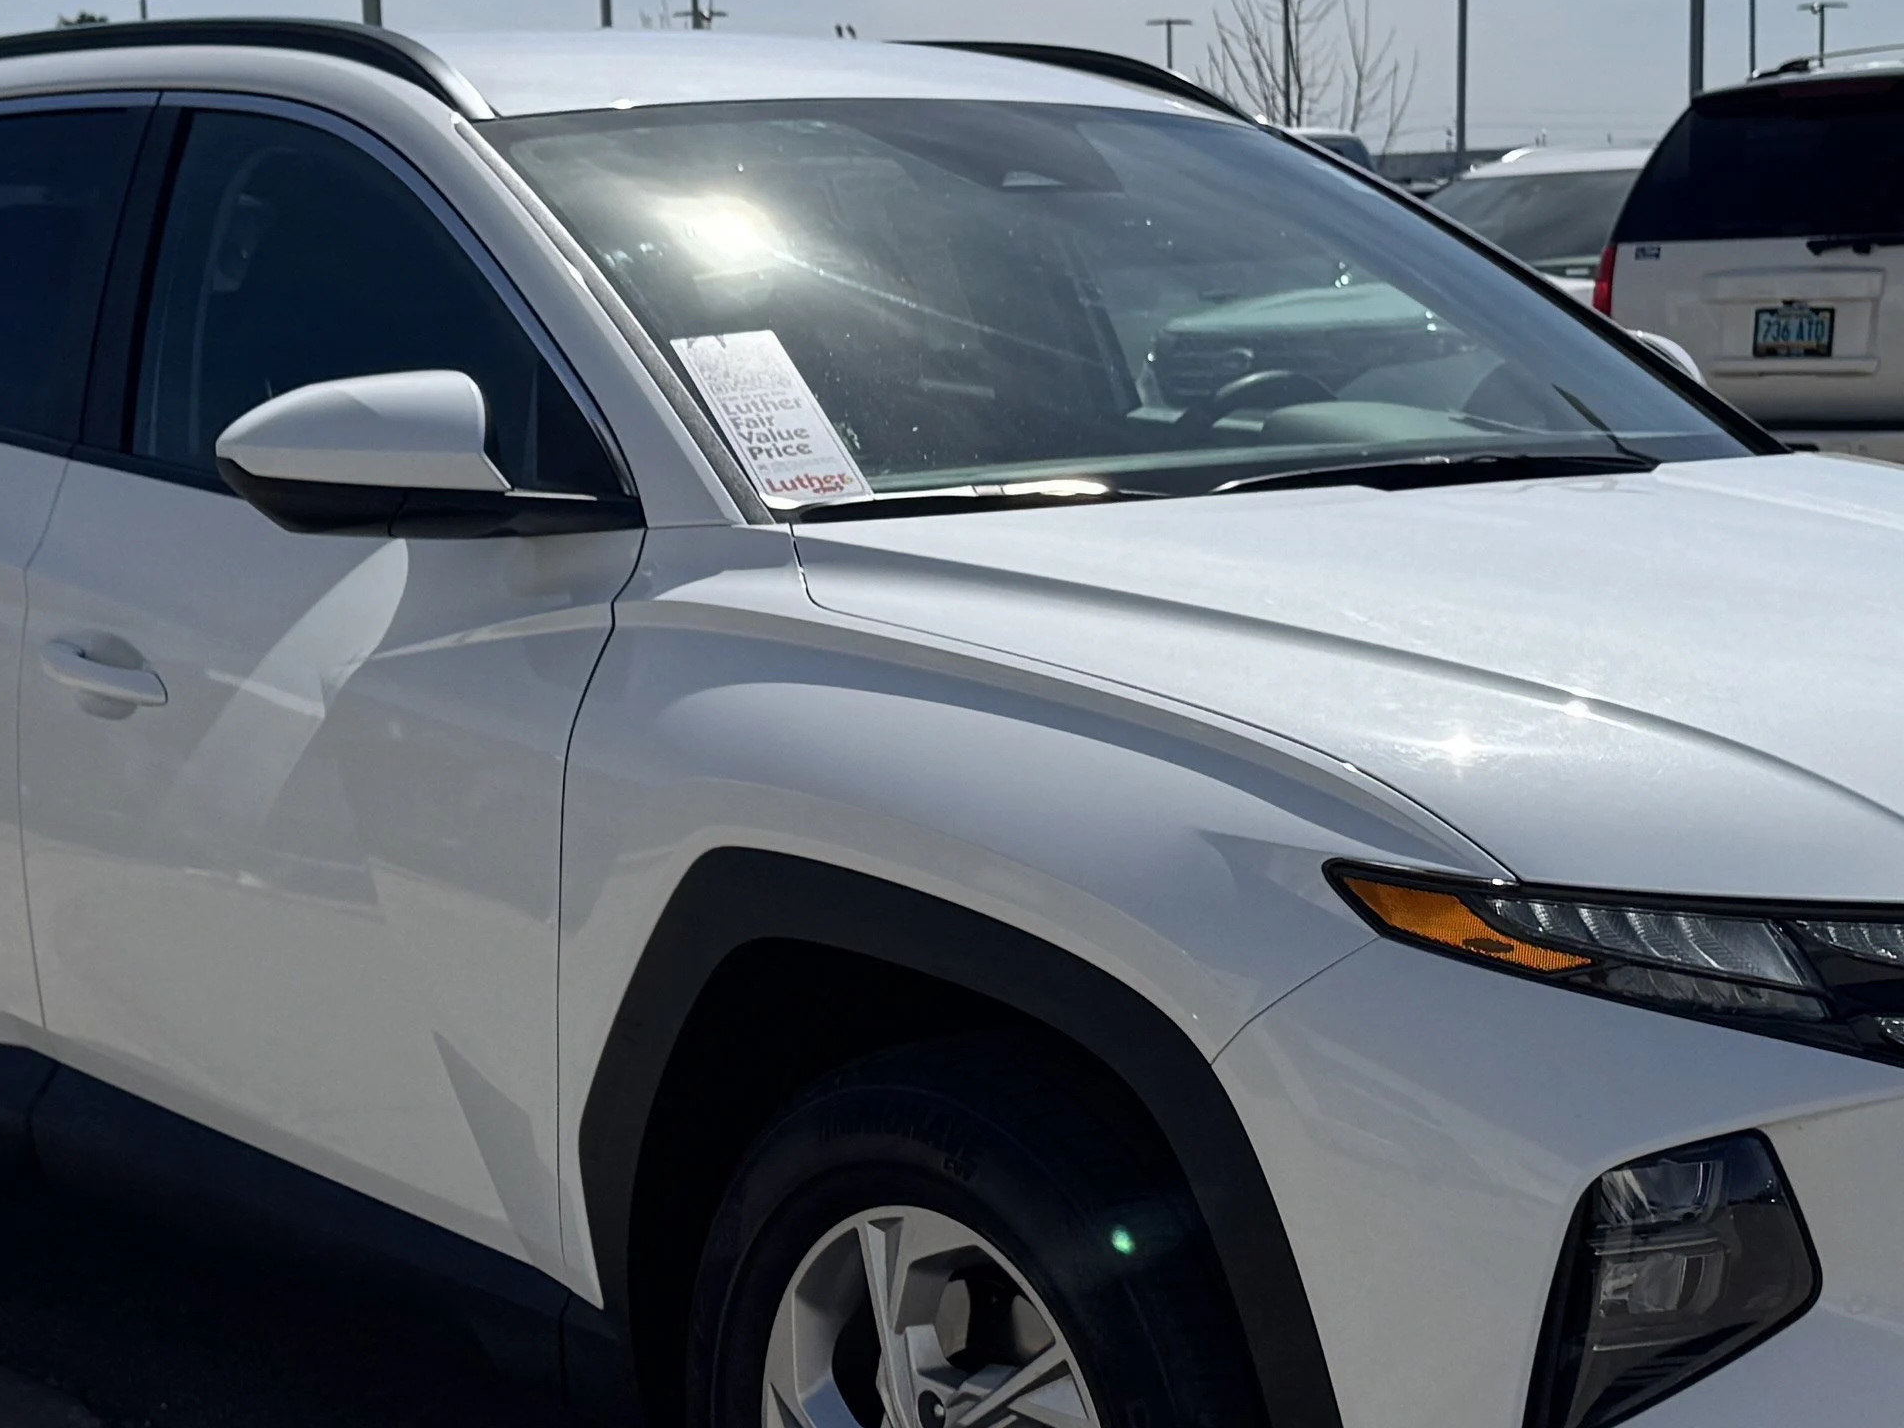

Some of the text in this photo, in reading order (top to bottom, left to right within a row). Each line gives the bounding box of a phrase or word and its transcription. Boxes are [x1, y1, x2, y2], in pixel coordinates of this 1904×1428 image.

[720, 396, 802, 416] Luther
[728, 412, 776, 430] Fair
[737, 427, 811, 445] Value
[748, 442, 813, 461] Price
[765, 473, 846, 493] Luther
